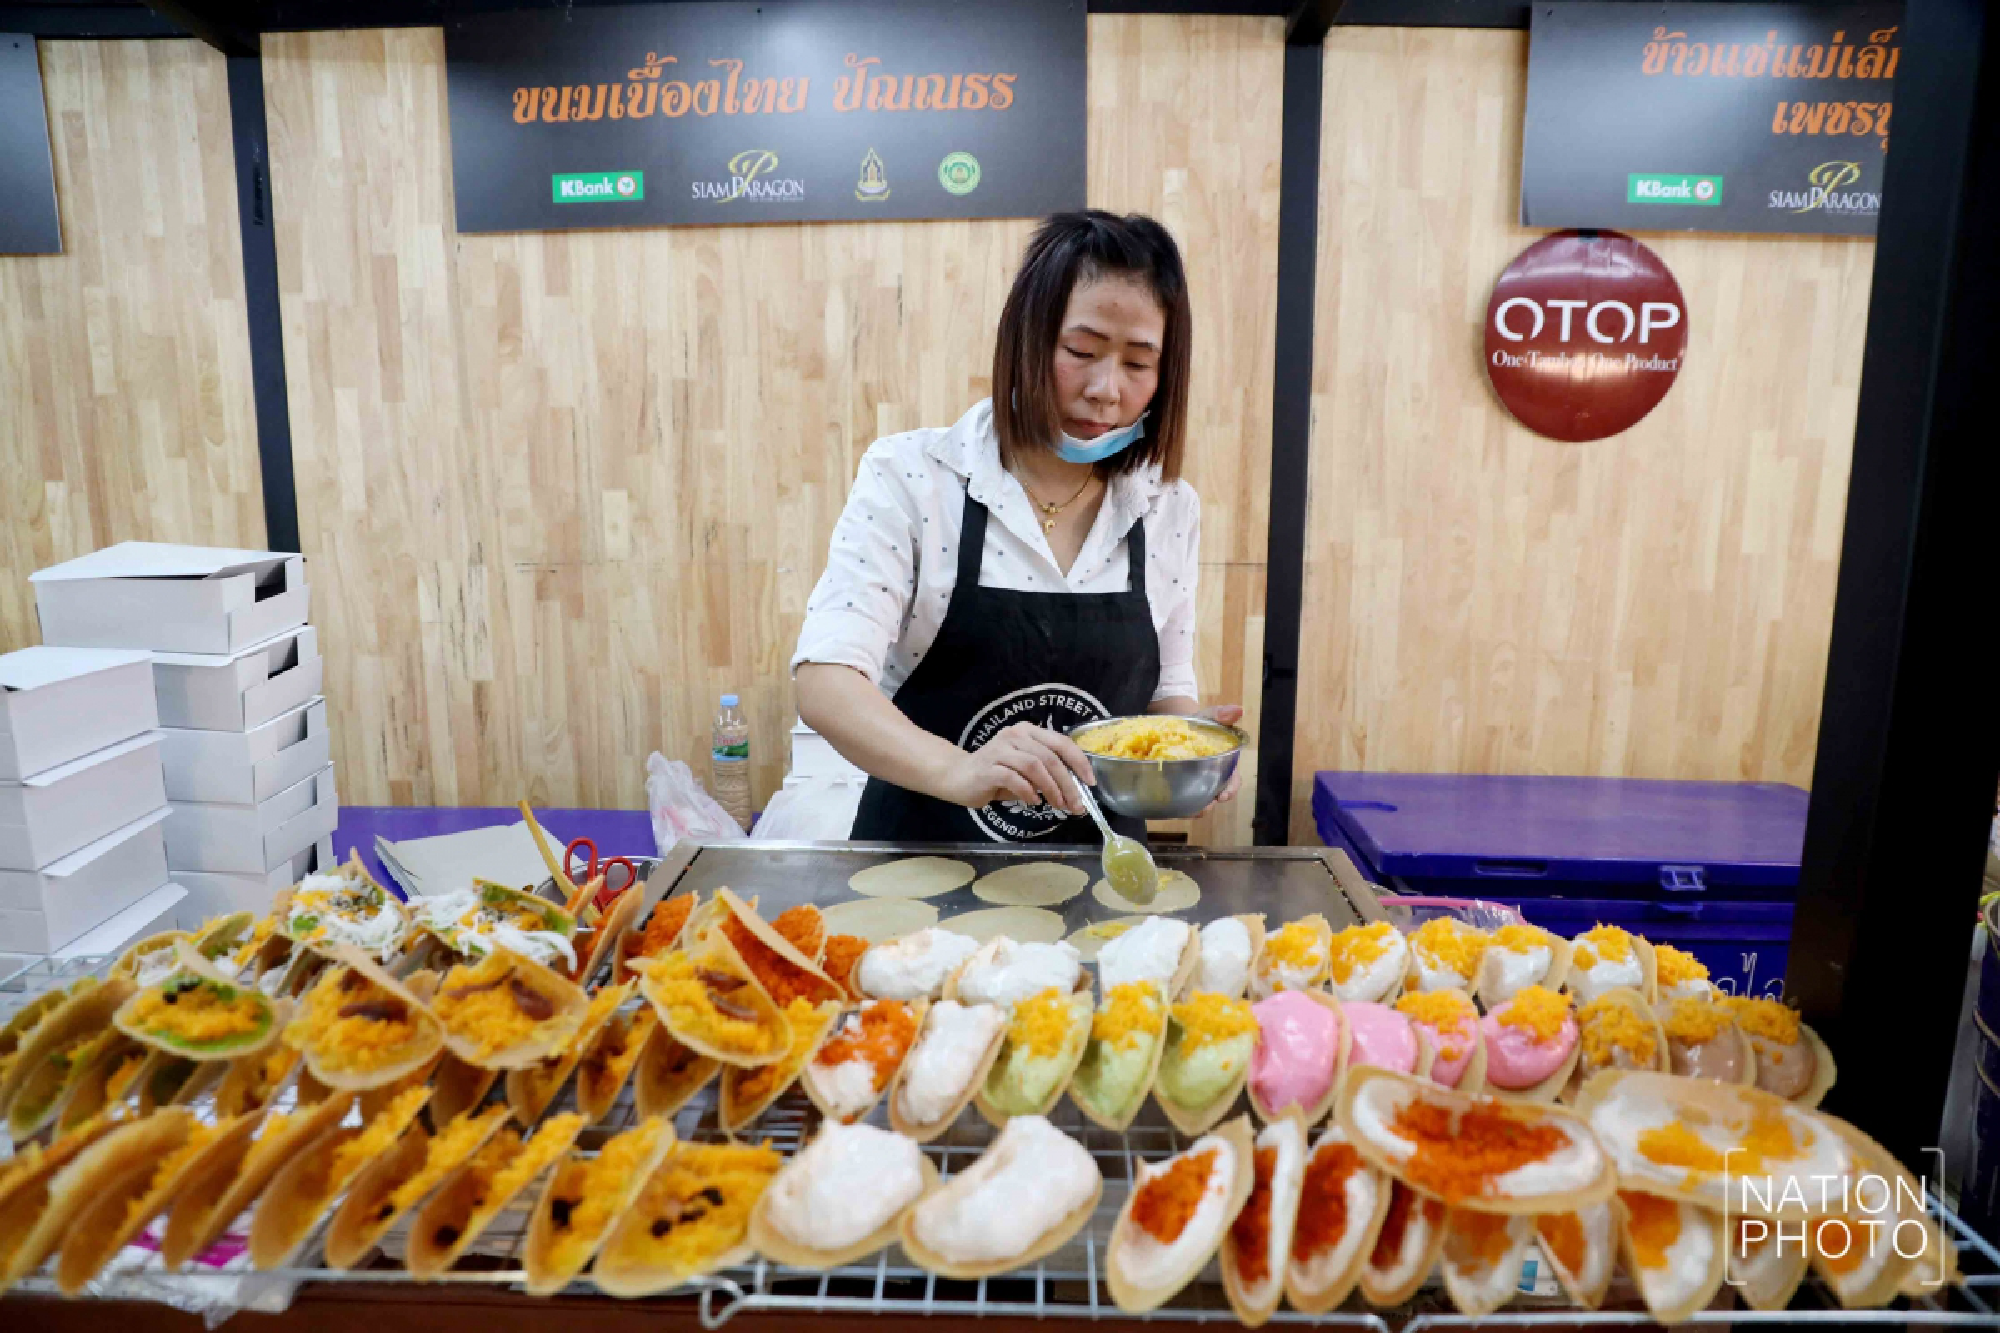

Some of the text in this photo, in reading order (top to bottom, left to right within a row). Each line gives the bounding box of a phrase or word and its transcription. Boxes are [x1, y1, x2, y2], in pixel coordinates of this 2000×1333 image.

[512, 51, 1018, 125] ขนมเบื้องไทย ปัณณธร
[561, 177, 614, 197] KBank
[692, 176, 804, 199] SIAM PARAGON
[1637, 179, 1691, 199] KBank
[1768, 186, 1881, 209] SIAM PARAGON
[1494, 297, 1681, 344] OTOP
[1492, 350, 1523, 368] One
[1625, 352, 1678, 372] Product
[1039, 694, 1093, 718] STREET
